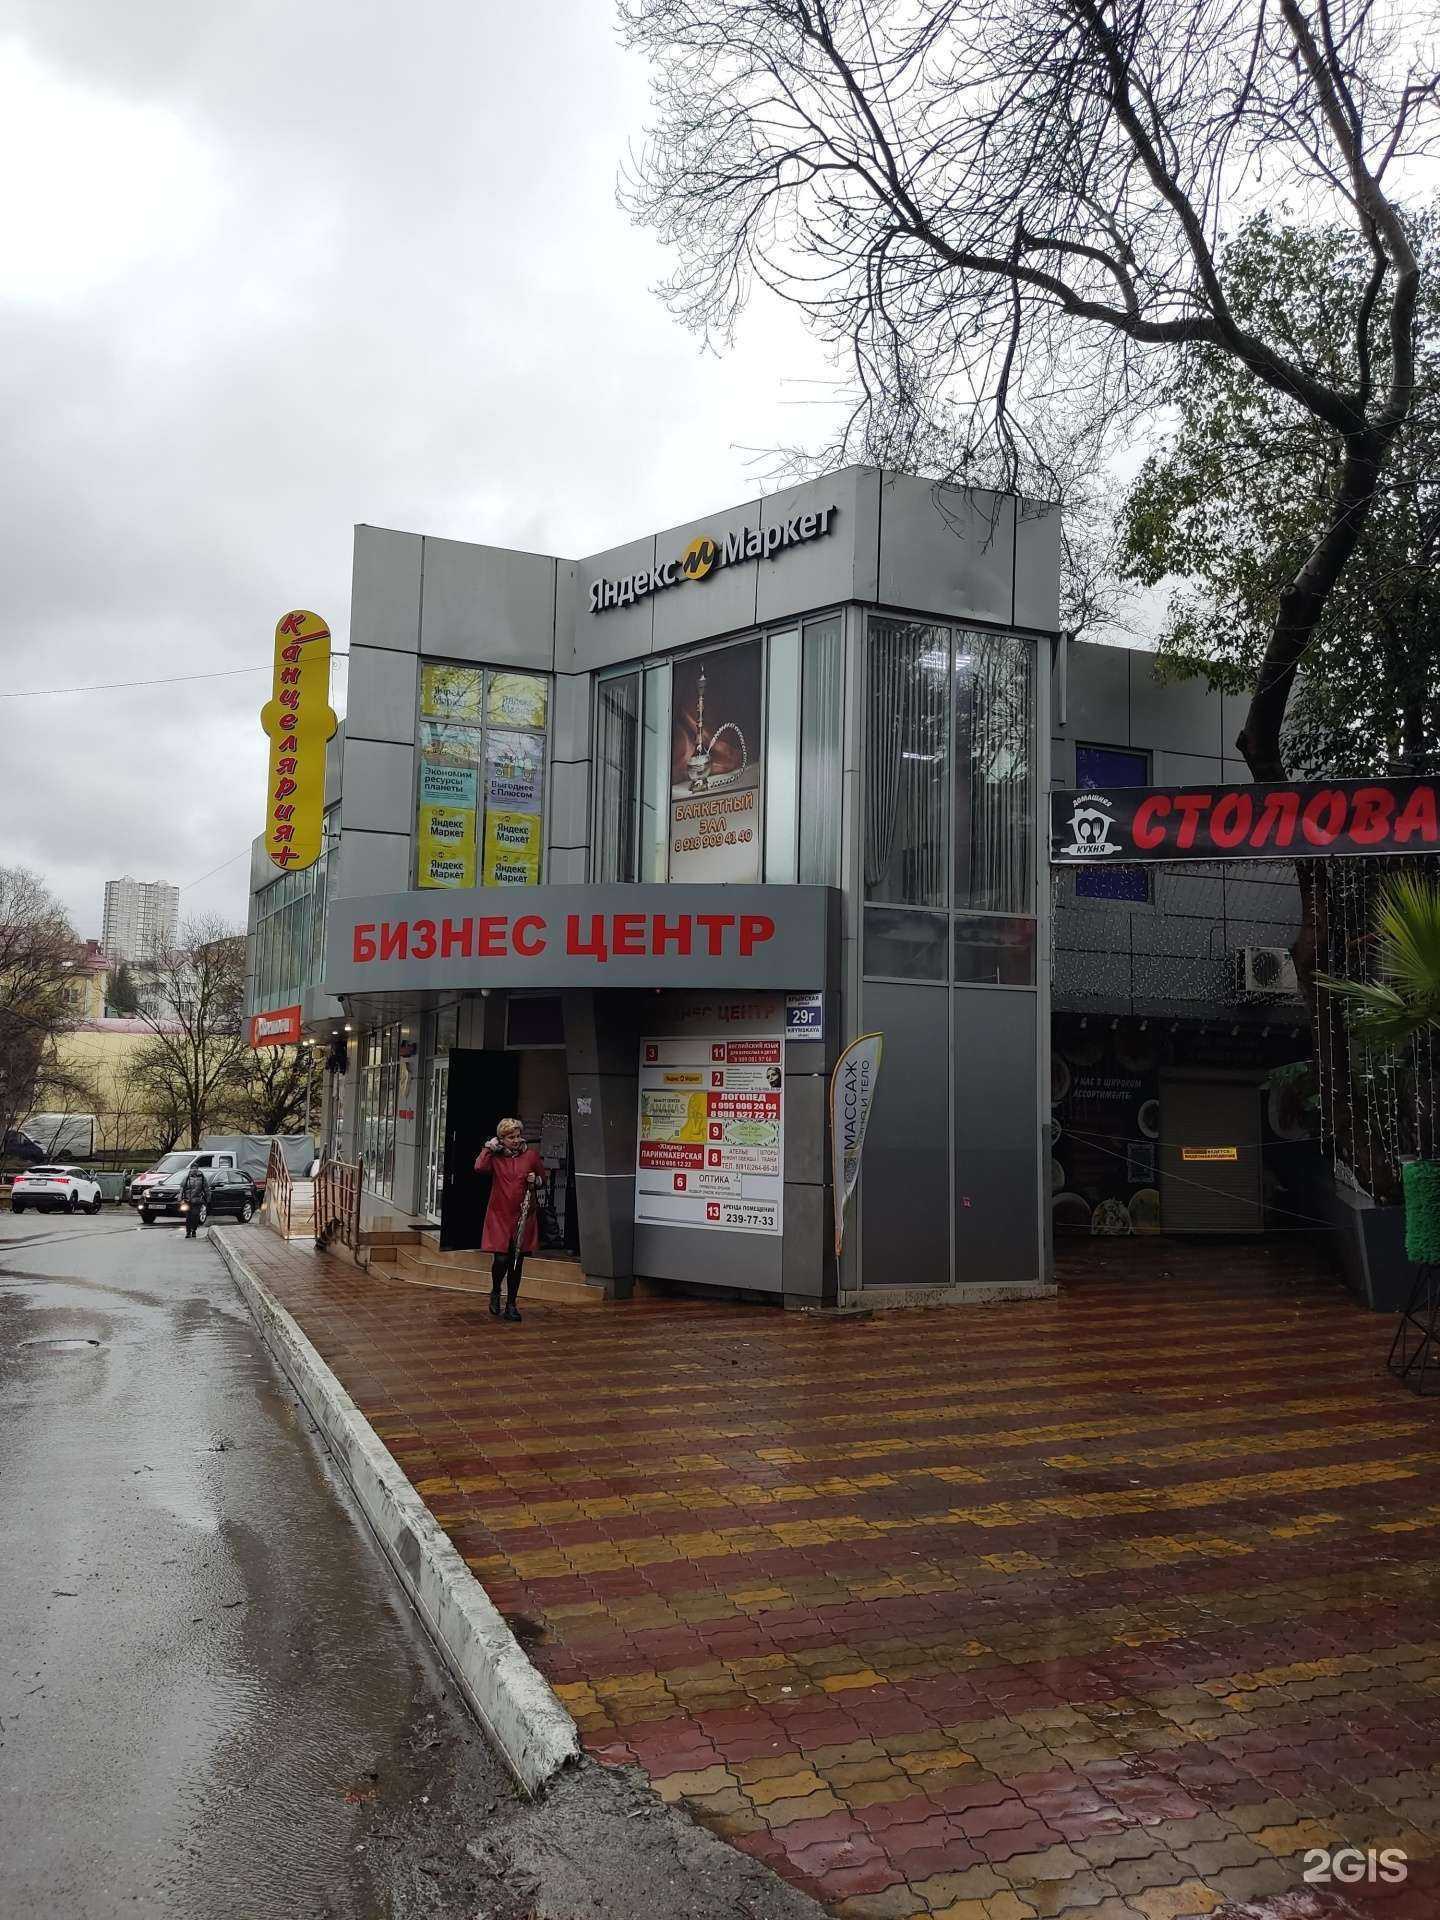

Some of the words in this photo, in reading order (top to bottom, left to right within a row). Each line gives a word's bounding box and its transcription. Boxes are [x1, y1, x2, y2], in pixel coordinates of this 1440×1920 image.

[588, 559, 678, 613] Яндекс
[721, 504, 836, 567] Маркет
[425, 767, 472, 778] Экономим
[425, 776, 463, 786] ресурсы
[491, 780, 534, 792] Выгоднее
[425, 784, 463, 793] планеты
[497, 788, 533, 799] Плюсом
[676, 791, 754, 821] БАНКЕТНЫЙ
[1073, 793, 1113, 808] ДОМАШНЯЯ
[431, 817, 464, 829] Яндекс
[699, 816, 727, 834] ЗАЛ
[430, 826, 464, 838] Маркет
[497, 823, 529, 835] Яндекс
[496, 832, 530, 844] Маркет
[675, 839, 682, 852] 8
[682, 836, 701, 851] 918
[702, 833, 723, 848] 909
[724, 830, 737, 845] 41
[738, 828, 753, 843] 40
[1077, 844, 1106, 854] КУХНЯ
[431, 859, 464, 870] Яндекс
[495, 863, 527, 874] Яндекс
[430, 869, 465, 879] Маркет
[494, 872, 528, 884] Маркет
[352, 914, 548, 963] БИЗНЕС
[566, 914, 776, 963] ЦЕНТР
[792, 1009, 815, 1024] 29г
[648, 1048, 655, 1058] 3
[714, 1048, 724, 1058] 11
[714, 1073, 721, 1085] 2
[860, 1060, 870, 1094] ТЕЛО
[720, 1093, 766, 1102] ЛОГОПЕД
[860, 1098, 868, 1107] И
[844, 1060, 858, 1150] МАССАЖ
[712, 1127, 719, 1137] 9
[641, 1151, 702, 1160] ПАРИКМАХЕРСКАЯ
[711, 1153, 718, 1163] 8
[677, 1178, 683, 1187] 6
[699, 1174, 730, 1184] ОПТИКА
[707, 1206, 719, 1217] 13
[726, 1213, 774, 1226] 239-77-33
